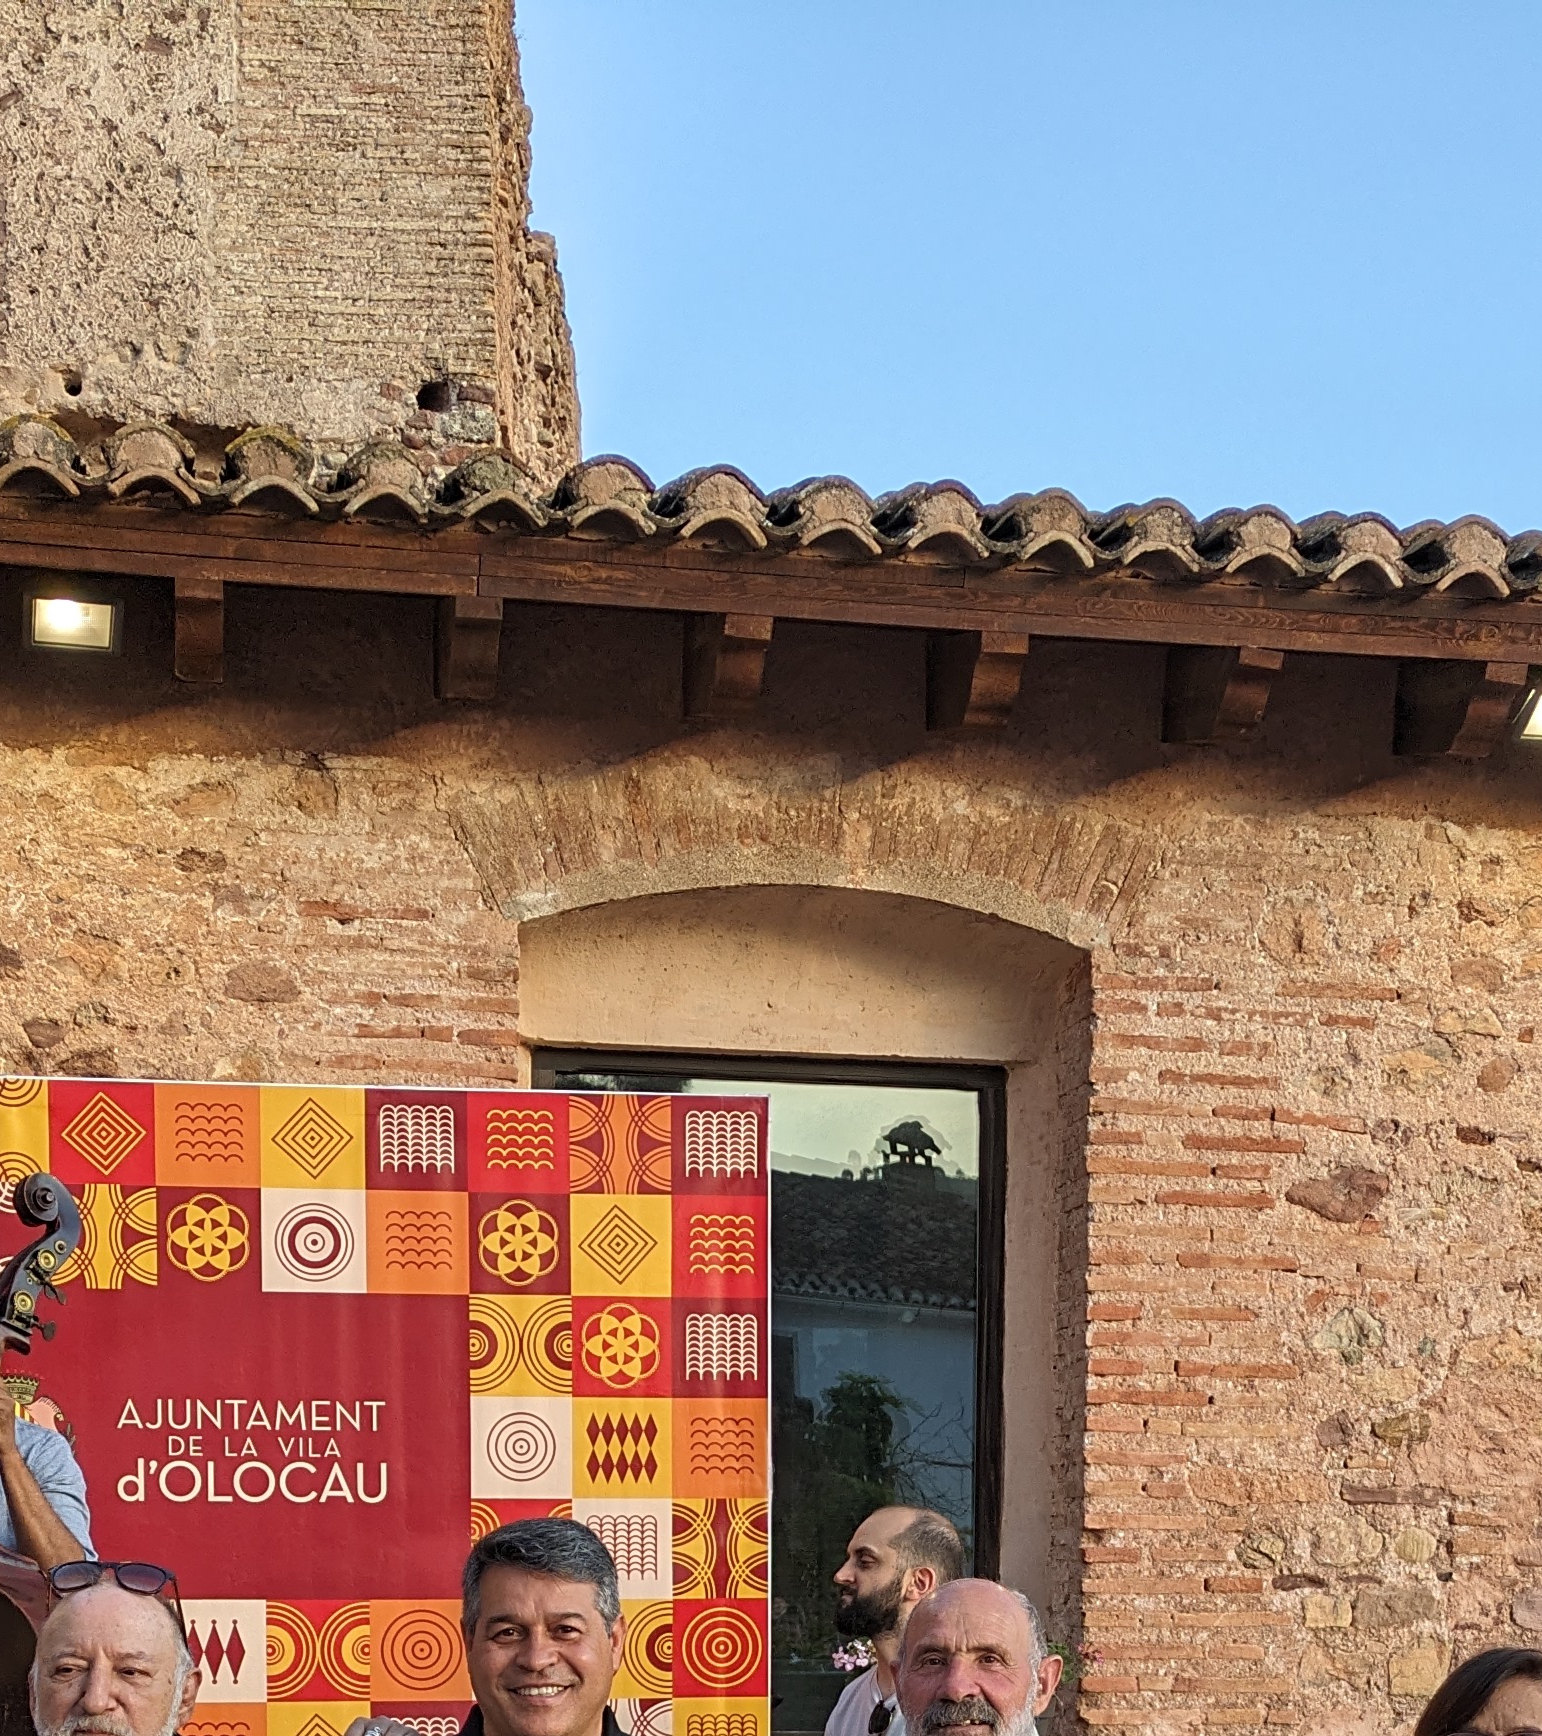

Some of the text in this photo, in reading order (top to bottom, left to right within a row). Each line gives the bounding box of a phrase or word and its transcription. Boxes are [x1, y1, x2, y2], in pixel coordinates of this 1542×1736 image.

[116, 1398, 387, 1432] AJUNTAMENT
[168, 1435, 342, 1458] DE LA VILA
[116, 1457, 388, 1504] d'OLOCAU
